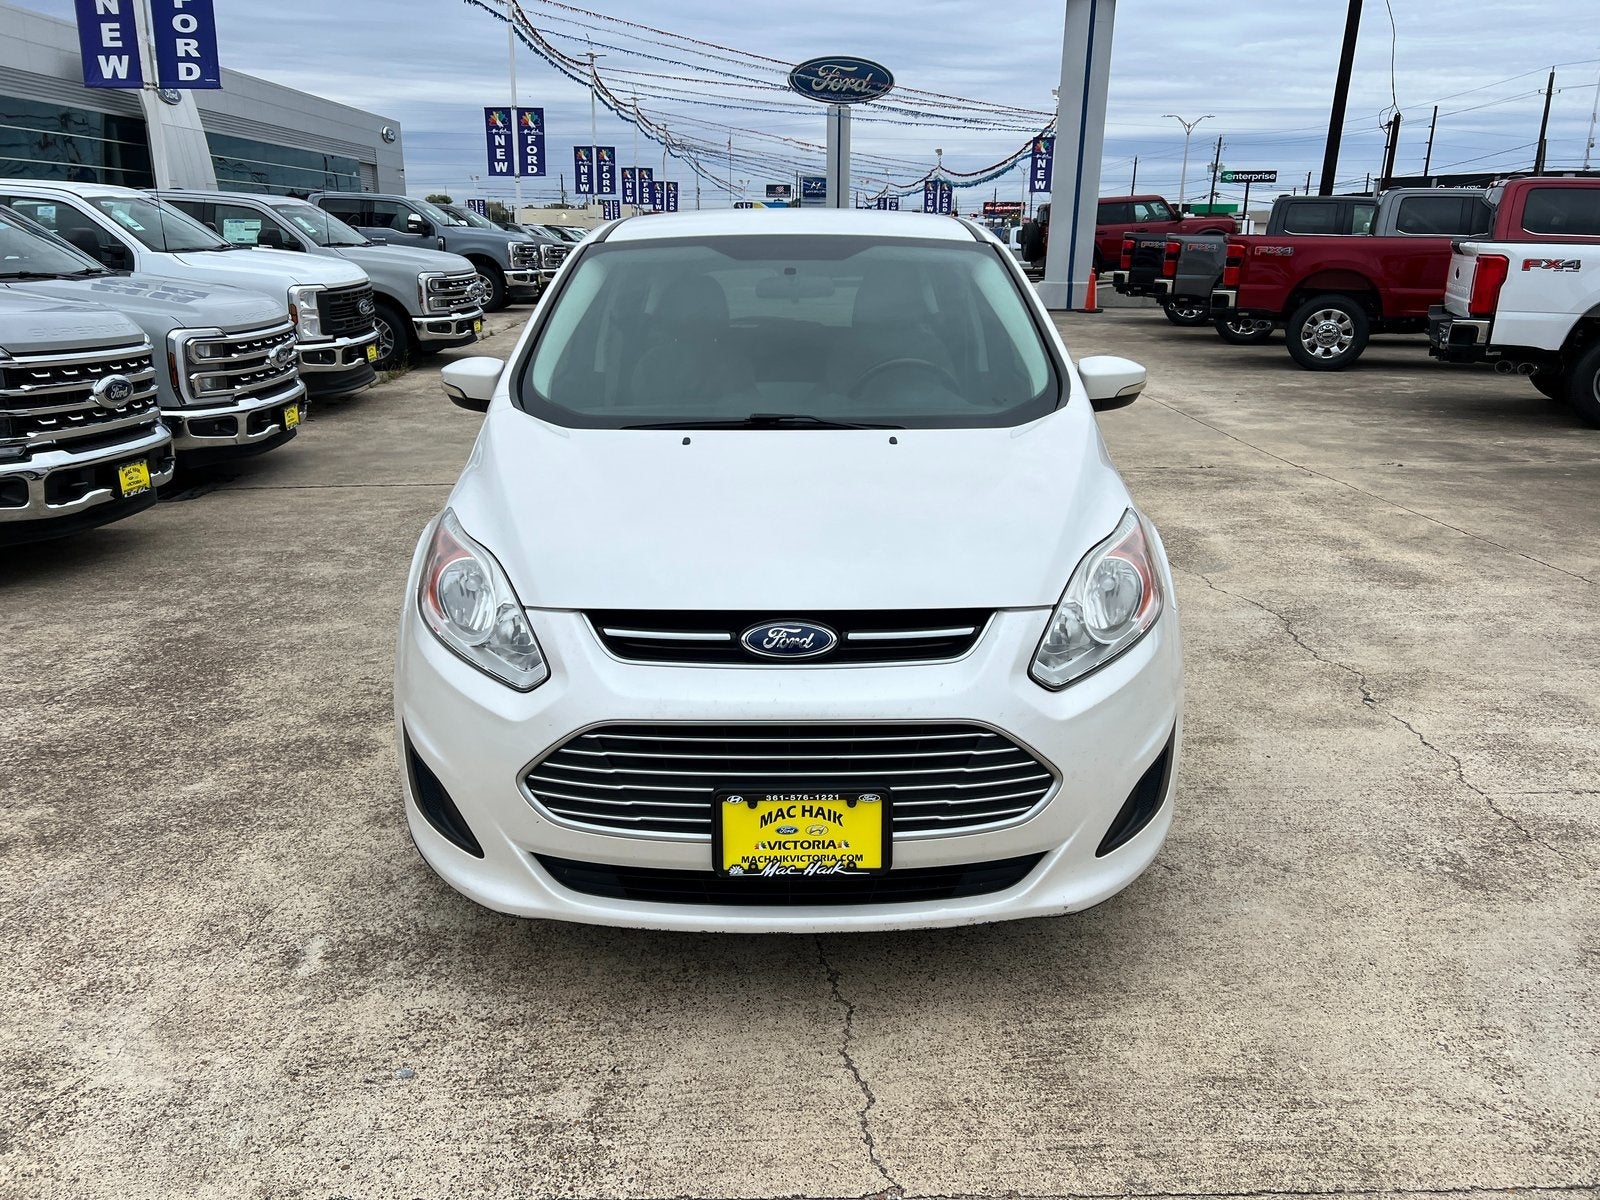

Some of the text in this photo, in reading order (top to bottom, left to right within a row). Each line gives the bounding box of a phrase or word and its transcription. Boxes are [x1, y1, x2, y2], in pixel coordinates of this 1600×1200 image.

[95, 0, 129, 80] NEW
[494, 135, 508, 173] NEW
[526, 135, 538, 174] FORD
[580, 165, 589, 192] NEW
[602, 166, 610, 193] FORD
[1034, 159, 1046, 190] NEW
[1226, 172, 1276, 181] enterprise
[625, 182, 633, 203] NEW
[926, 193, 934, 212] NEW
[1187, 243, 1217, 251] FX4
[1254, 246, 1294, 257] FX4
[1522, 259, 1581, 271] FX4
[759, 805, 844, 829] MAC HAIK
[767, 840, 837, 851] VICTORIA
[741, 854, 863, 864] MACHAIKVICTORIA.COM
[760, 861, 848, 877] Mac Haik
